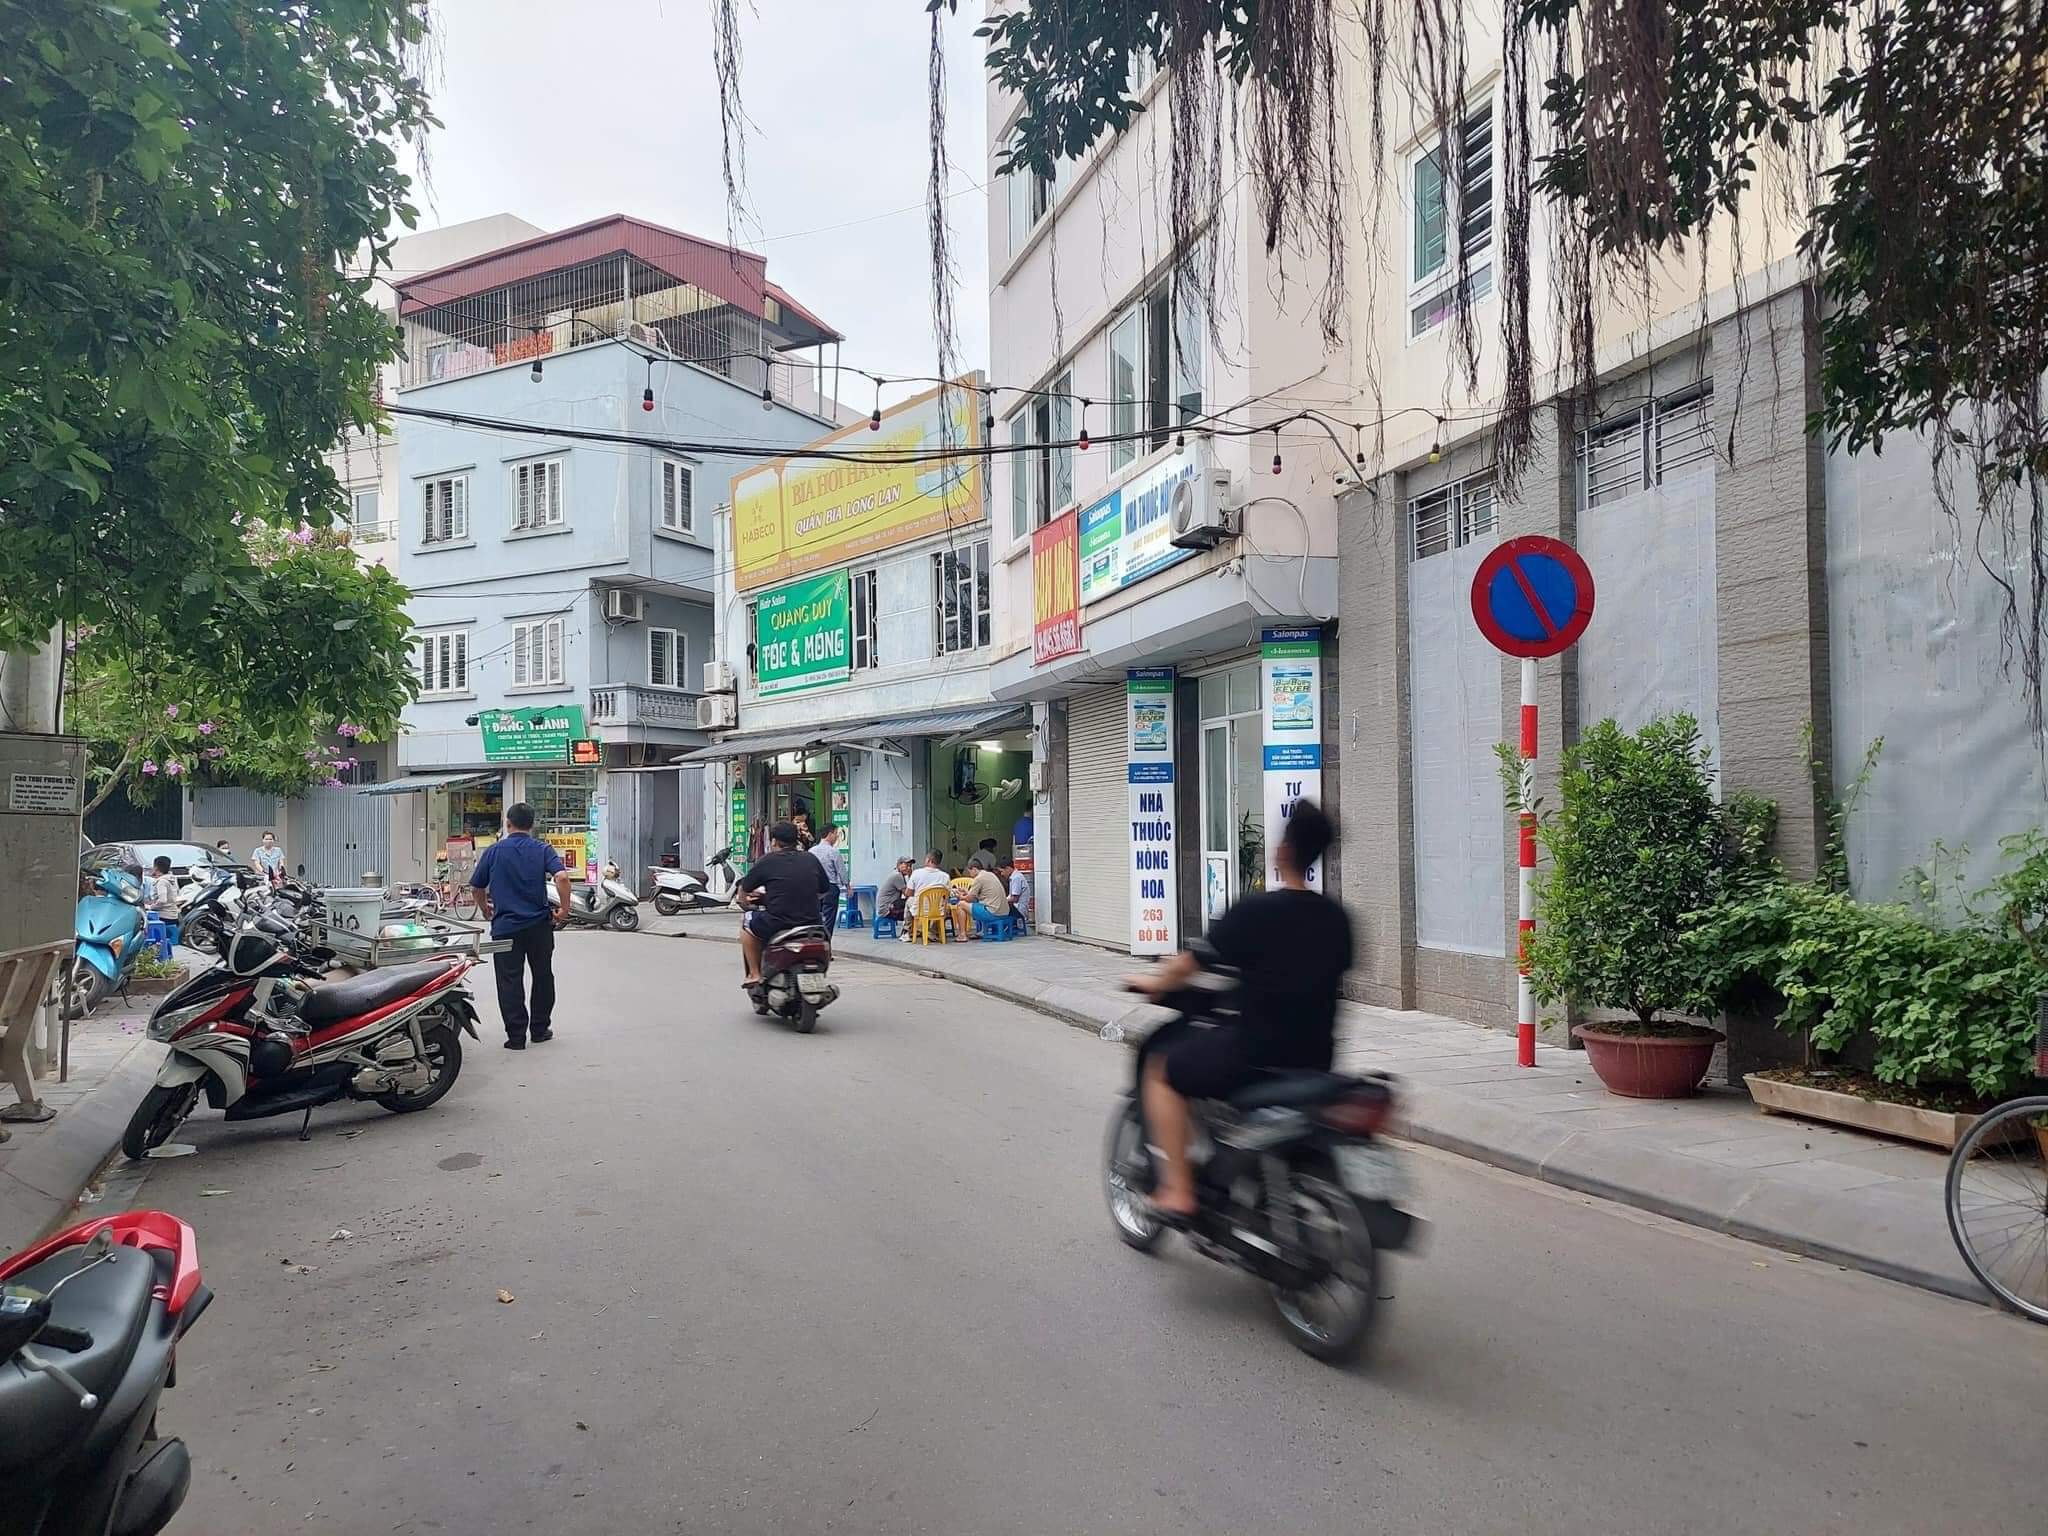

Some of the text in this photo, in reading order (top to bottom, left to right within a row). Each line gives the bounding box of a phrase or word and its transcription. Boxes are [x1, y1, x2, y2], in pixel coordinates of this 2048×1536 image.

[795, 483, 901, 536] QUÁN BIA LONG LAN
[742, 523, 775, 545] HABECO
[771, 598, 833, 630] QUANG DUY
[1272, 630, 1309, 640] Salonpas
[762, 626, 844, 671] TÓC & MÓNG
[1274, 685, 1310, 693] FEVER
[1286, 781, 1302, 796] TƯ
[1139, 790, 1163, 812] NHÀ
[1132, 816, 1171, 842] THUỐC
[1136, 844, 1169, 870] HỒNG
[1141, 879, 1165, 899] HOA
[1143, 909, 1163, 921] 263
